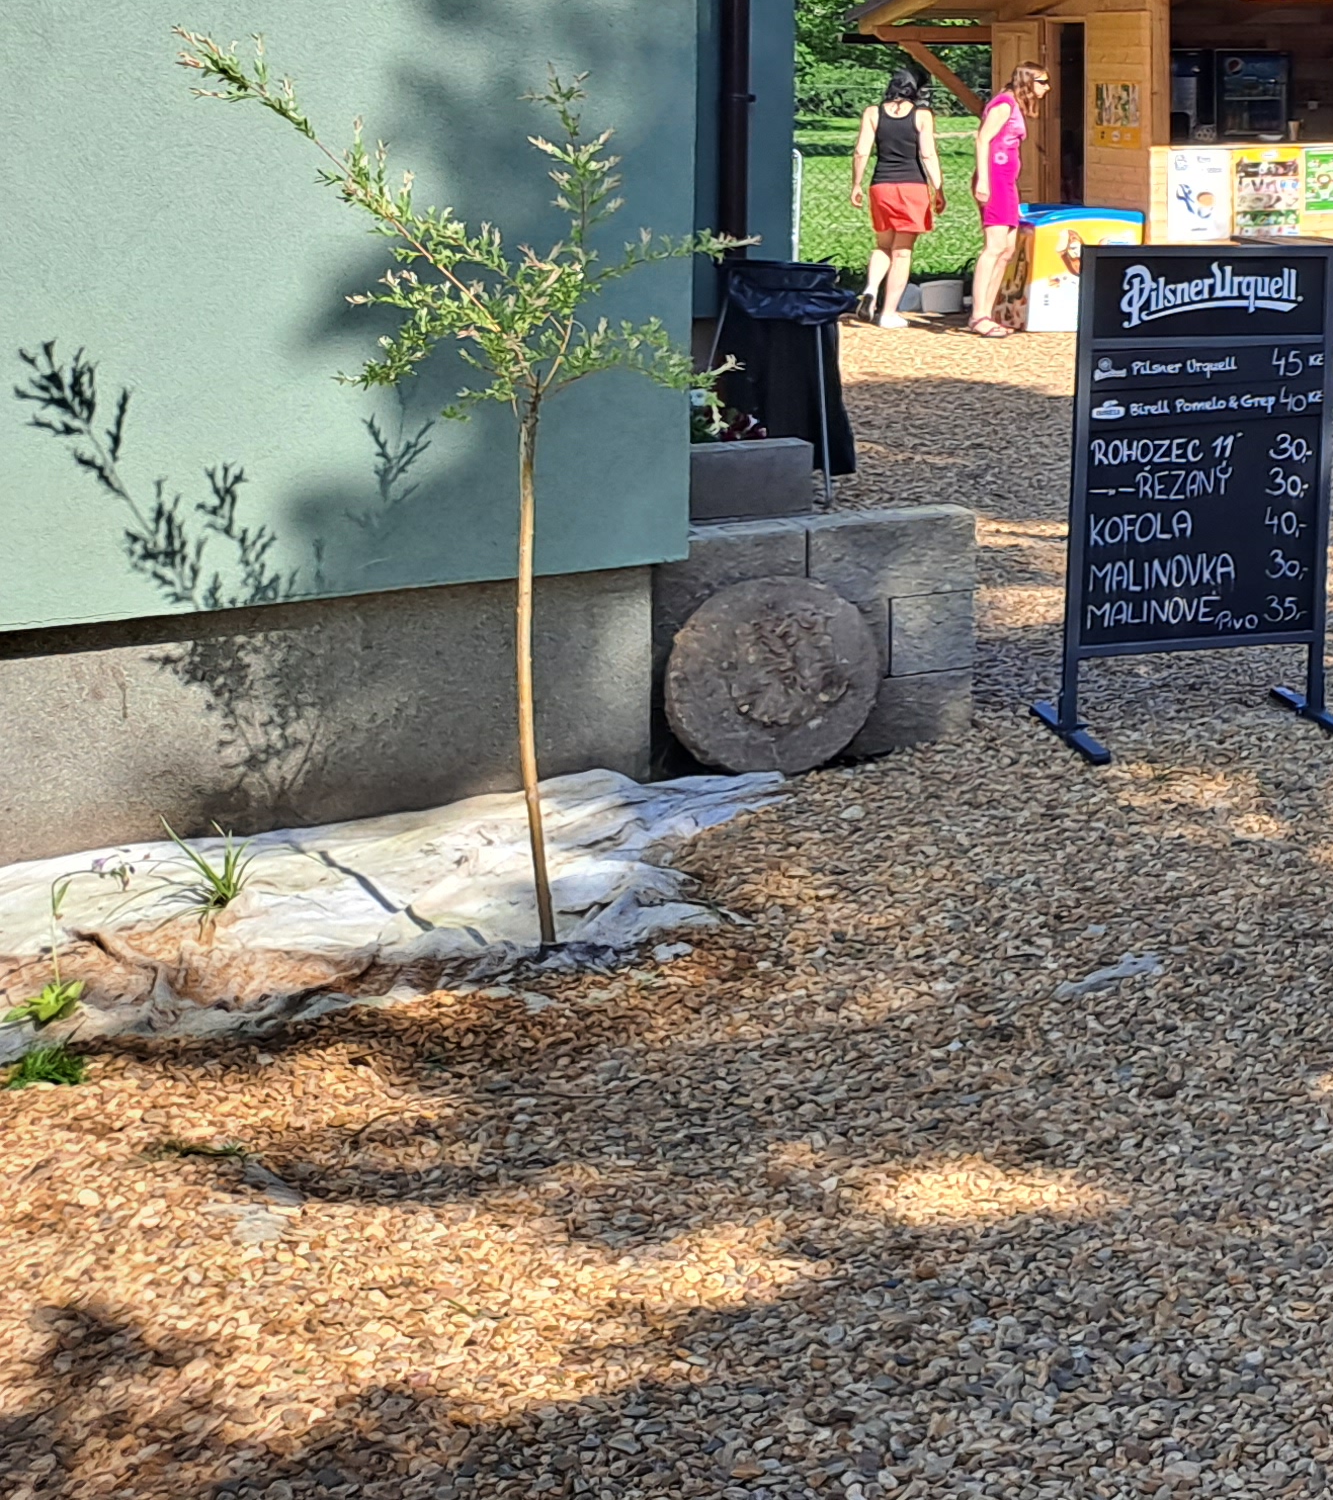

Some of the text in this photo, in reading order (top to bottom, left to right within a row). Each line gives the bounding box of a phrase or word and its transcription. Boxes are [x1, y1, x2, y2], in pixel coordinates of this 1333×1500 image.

[1120, 264, 1214, 328] Pilsner
[1130, 347, 1326, 379] Pilsner Urquell 45 Kč
[1129, 400, 1171, 416] Birell
[1175, 396, 1228, 413] Pomelo
[1228, 398, 1240, 409] &
[1240, 395, 1277, 414] Grep
[1278, 386, 1307, 413] 40
[1307, 390, 1325, 403] Kč
[1090, 439, 1204, 466] ROHOZEC
[1089, 510, 1193, 547] KOFOLA
[1088, 553, 1236, 594] MALINOVKA
